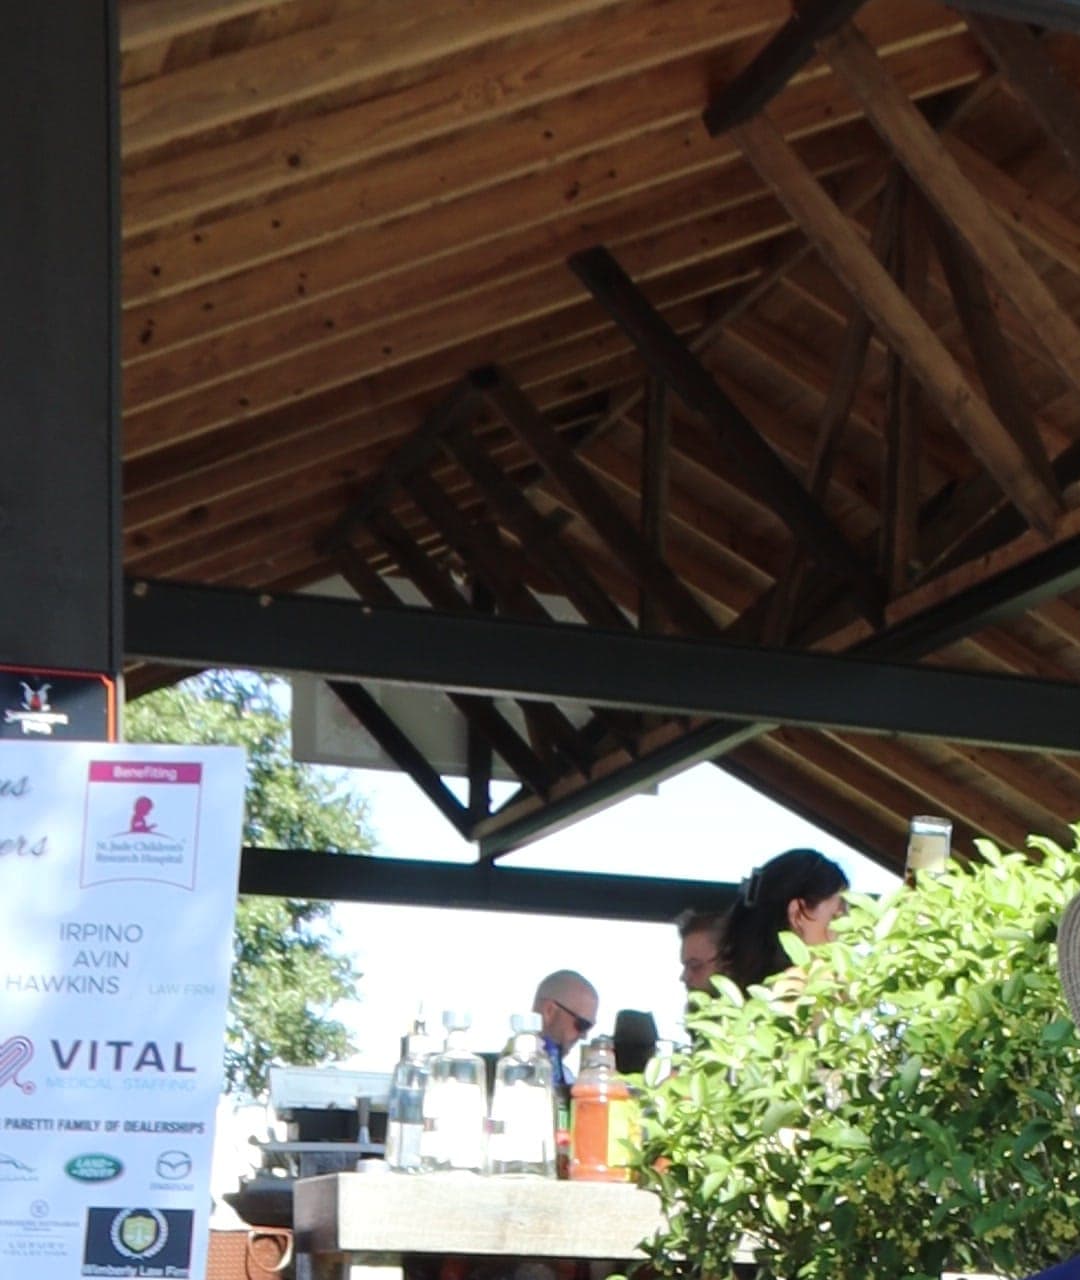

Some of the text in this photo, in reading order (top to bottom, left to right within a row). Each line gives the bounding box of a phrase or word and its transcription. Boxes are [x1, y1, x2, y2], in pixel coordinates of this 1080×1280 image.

[112, 766, 177, 781] Benefiting
[59, 922, 144, 944] IRPINO
[72, 950, 130, 968] AVIN
[6, 974, 120, 995] HAWKINS
[51, 1039, 197, 1073] VITAL
[5, 1117, 54, 1131] PARETTI
[57, 1119, 100, 1132] FAMILY
[104, 1120, 120, 1132] OF
[123, 1120, 205, 1134] DEALERSHIPS
